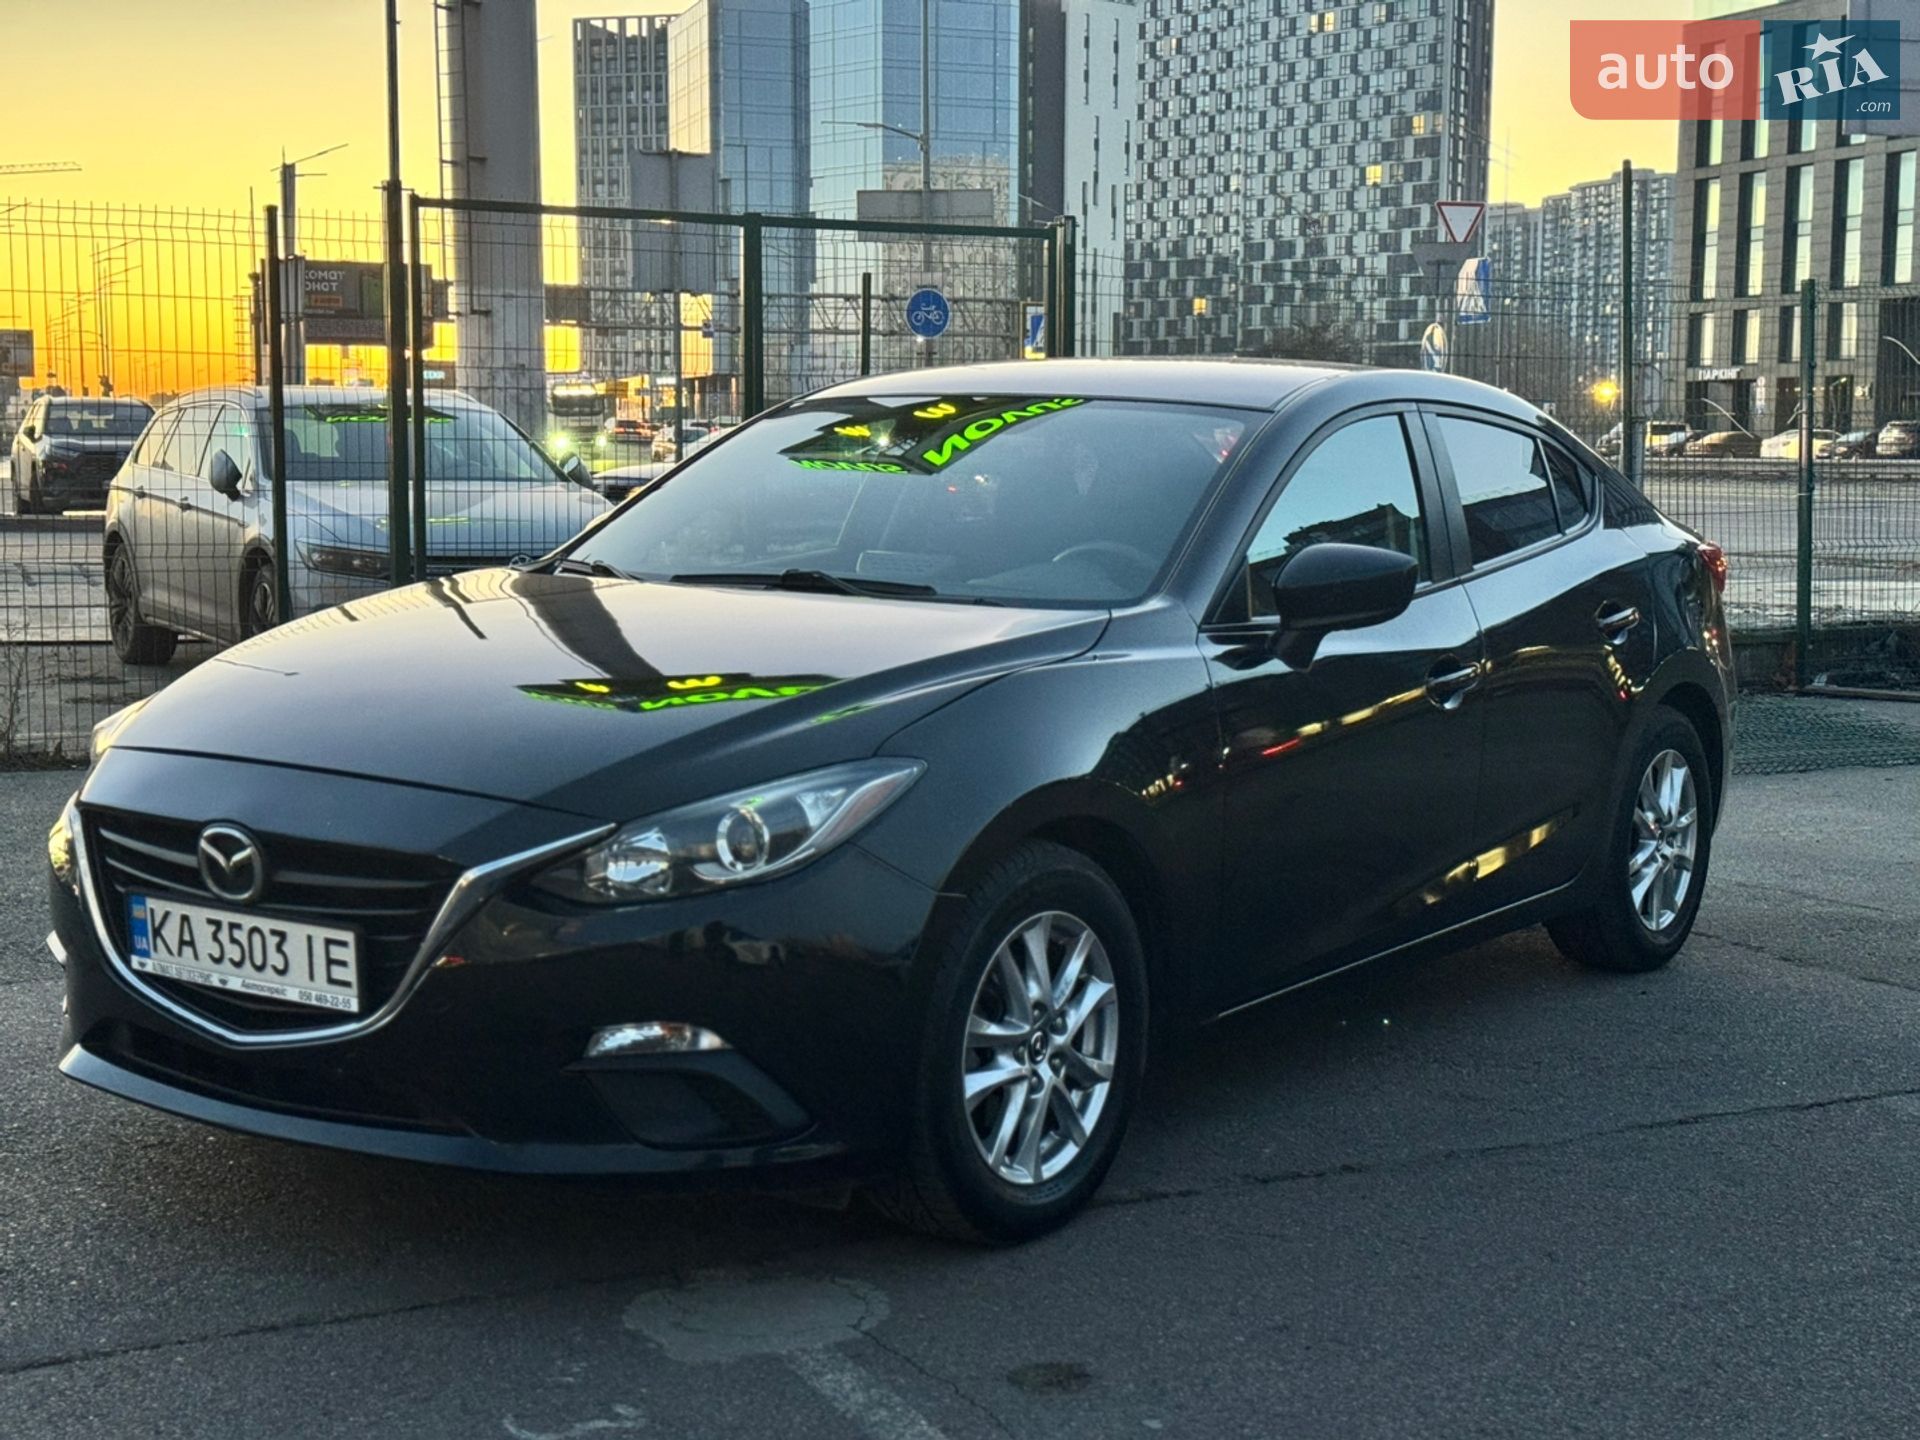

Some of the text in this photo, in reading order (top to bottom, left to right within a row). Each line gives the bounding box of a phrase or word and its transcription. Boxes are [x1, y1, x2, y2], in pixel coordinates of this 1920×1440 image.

[149, 906, 199, 961] KA
[205, 917, 290, 977] 3503
[306, 933, 353, 989] IE
